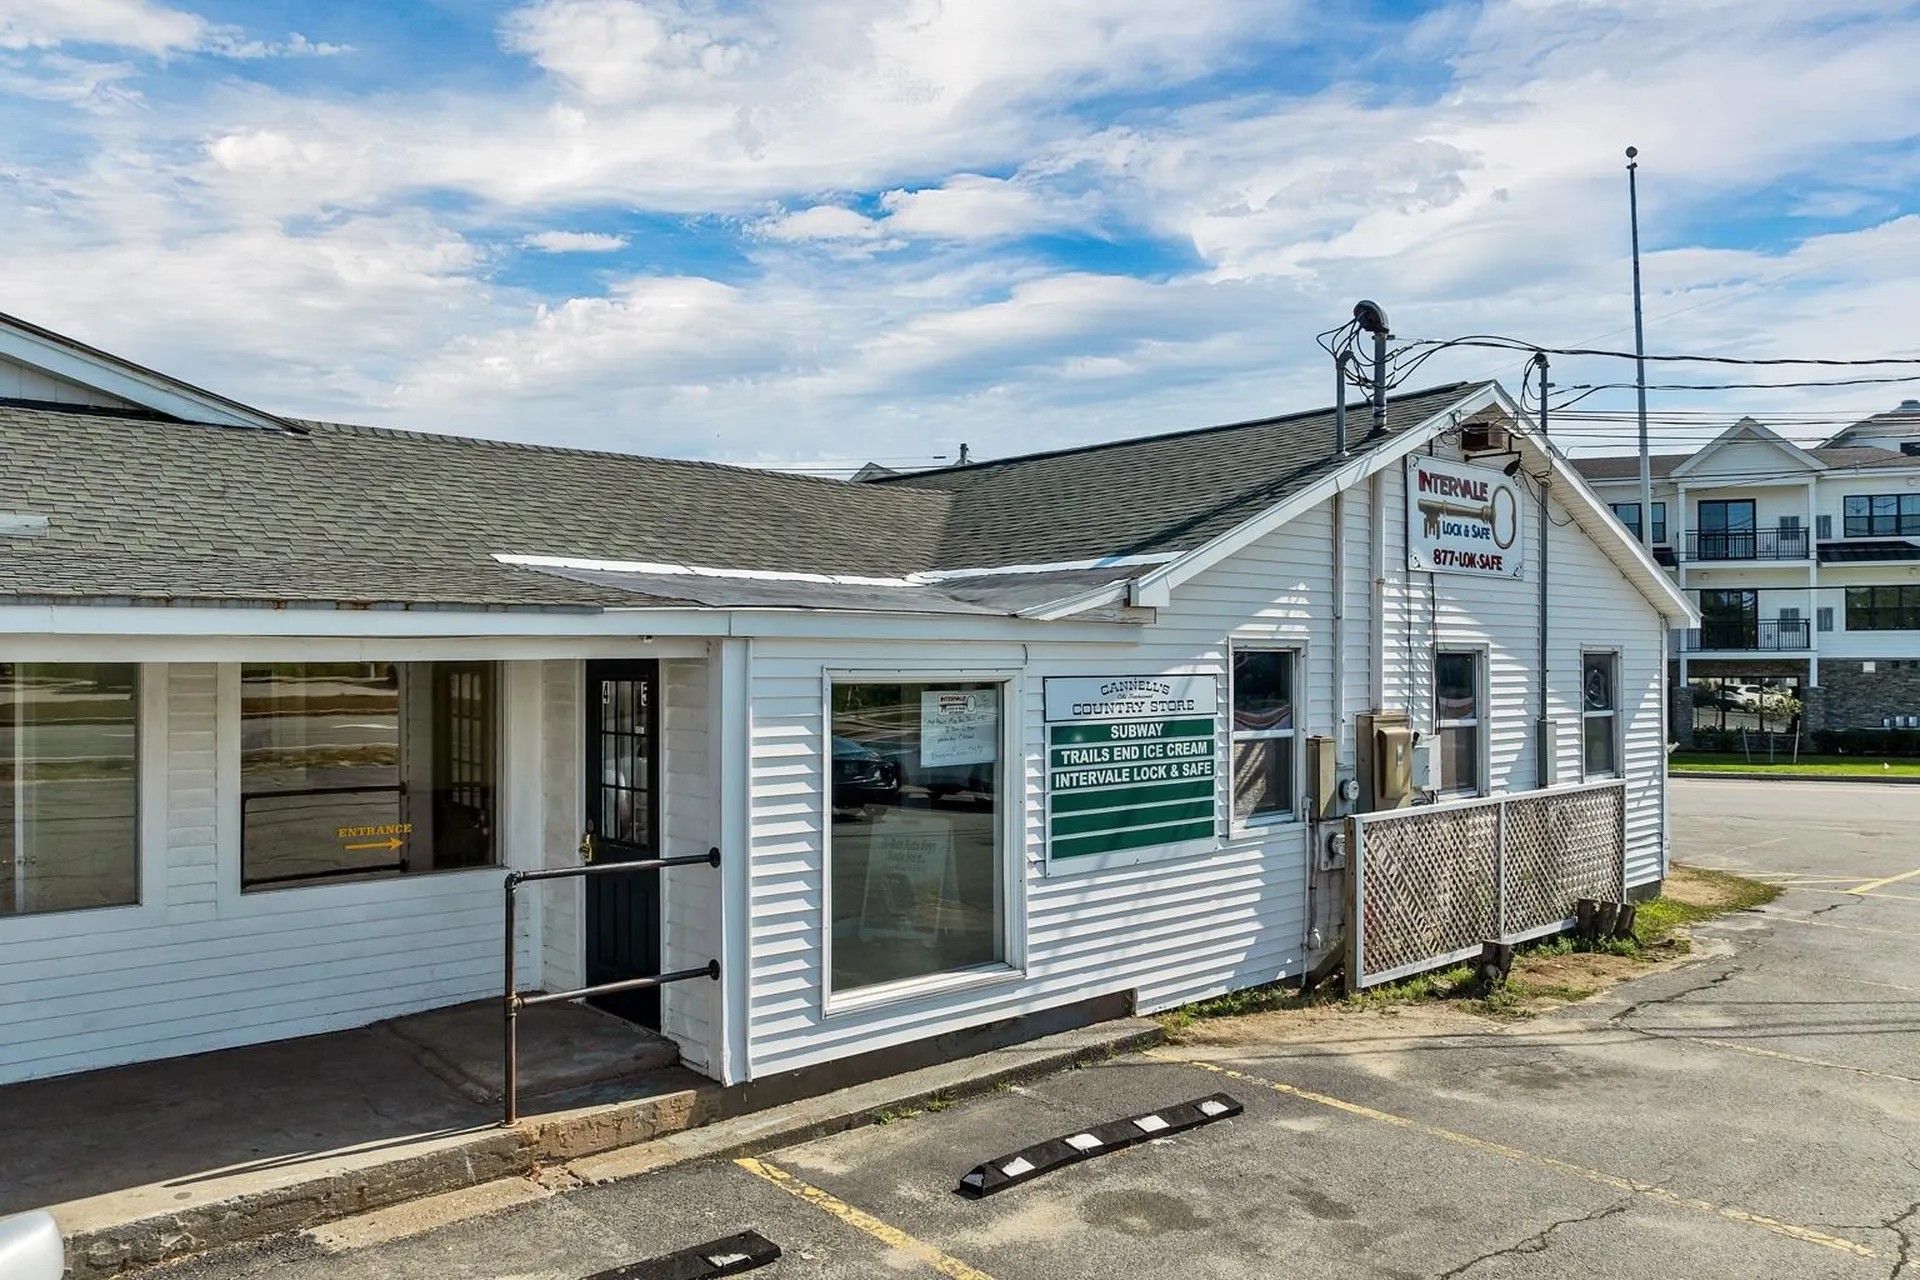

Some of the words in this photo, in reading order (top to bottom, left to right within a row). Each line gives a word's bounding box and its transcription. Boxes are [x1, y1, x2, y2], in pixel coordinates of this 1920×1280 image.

[1418, 470, 1488, 502] INTERVALE
[1443, 520, 1461, 537] LOCK
[1464, 524, 1470, 538] &
[1472, 524, 1490, 540] SAFE
[1101, 681, 1170, 695] CANNELL'S
[1072, 700, 1145, 715] COUNTRY
[1151, 699, 1195, 712] STORE
[1111, 723, 1163, 739] SUBWAY
[1061, 747, 1109, 765] TRAILS
[1113, 745, 1139, 761] END
[1143, 744, 1163, 759] ICE
[1167, 741, 1207, 756] CREAM
[1055, 769, 1130, 788] INTERVALE
[1134, 765, 1167, 781] LOCK
[1170, 763, 1179, 777] &
[1182, 761, 1211, 776] SAFE
[338, 823, 412, 838] ENTRANCE
